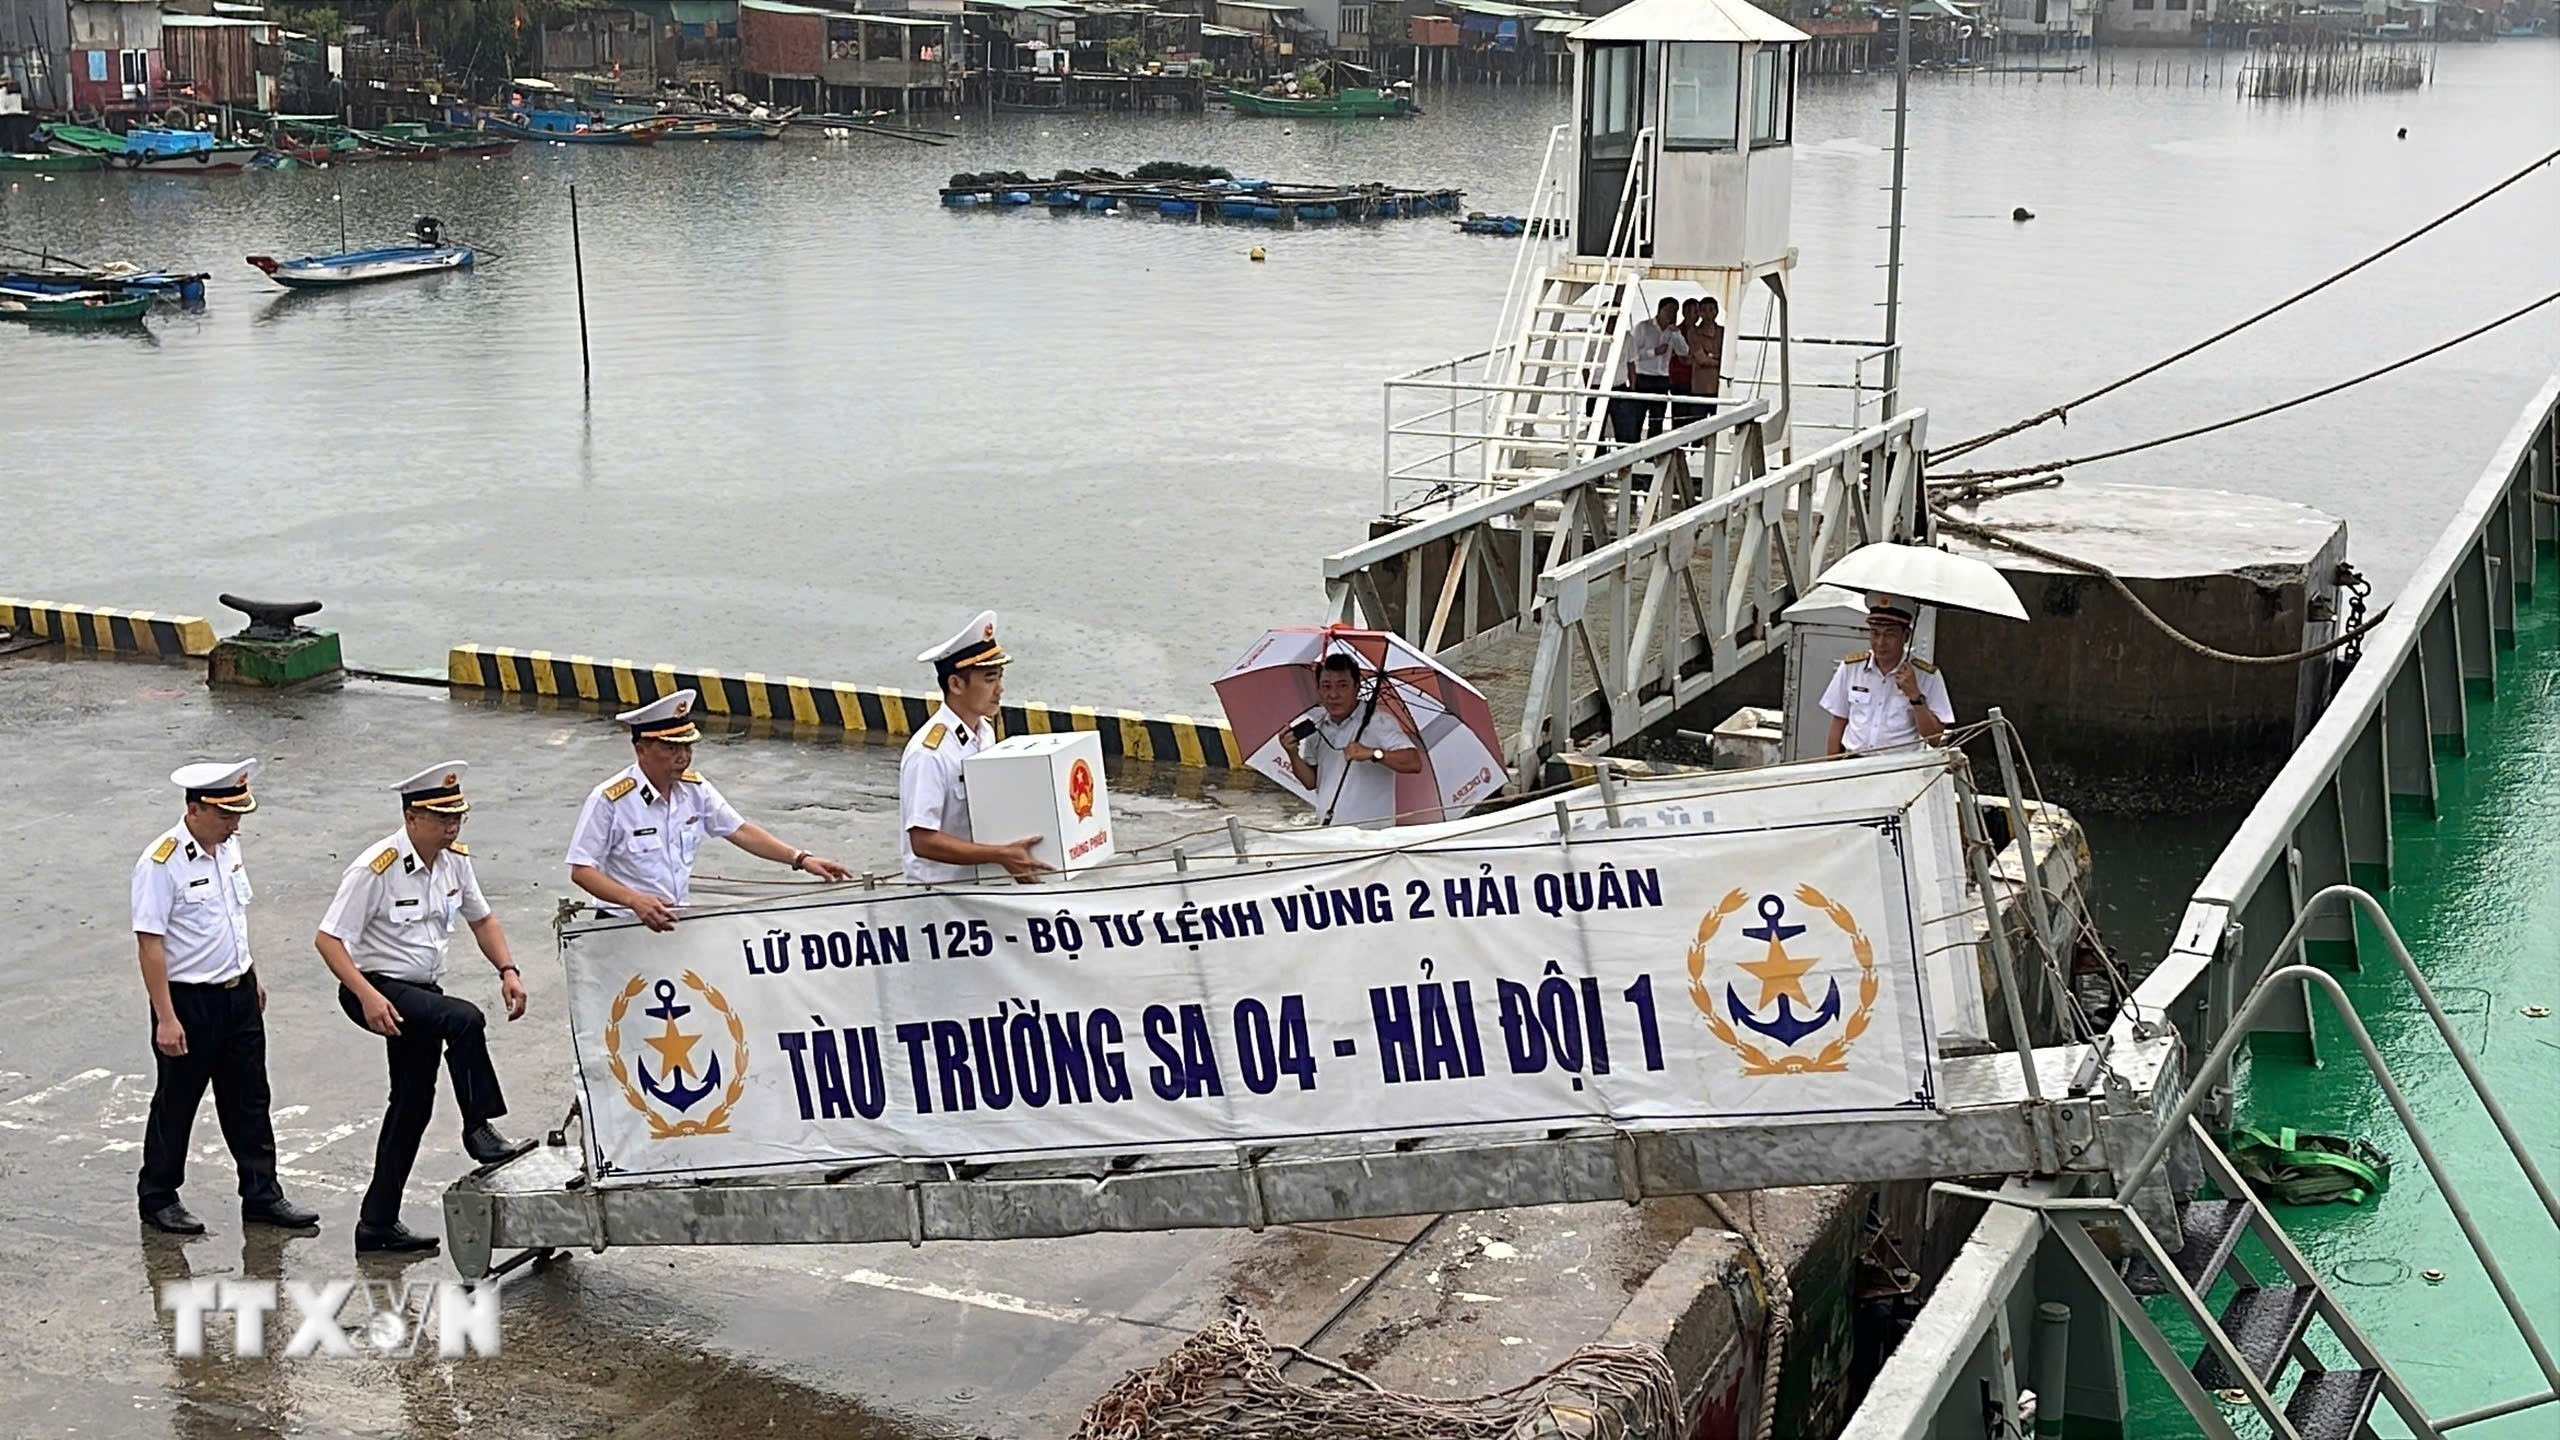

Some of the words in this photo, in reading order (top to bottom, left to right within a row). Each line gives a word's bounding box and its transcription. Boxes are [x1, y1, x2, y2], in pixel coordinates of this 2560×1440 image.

[743, 928, 791, 974] LỮ
[801, 921, 910, 970] ĐOÀN
[921, 919, 993, 960] 125
[1027, 910, 1083, 960] BỘ
[1090, 909, 1145, 948] TƯ
[1153, 901, 1265, 950] LỆNH
[1271, 885, 1393, 932] VÙNG
[1406, 879, 1435, 919] 2
[1444, 863, 1519, 917] HẢI
[1535, 863, 1663, 918] QUÂN
[778, 1015, 887, 1120] TÀU
[896, 998, 1133, 1114] TRƯỜNG
[1143, 1003, 1225, 1101] SA
[1234, 994, 1318, 1094] 04
[1333, 1038, 1357, 1057] -
[1369, 958, 1486, 1083] HẢI
[1497, 960, 1610, 1091] ĐỘI
[1624, 973, 1665, 1072] 1
